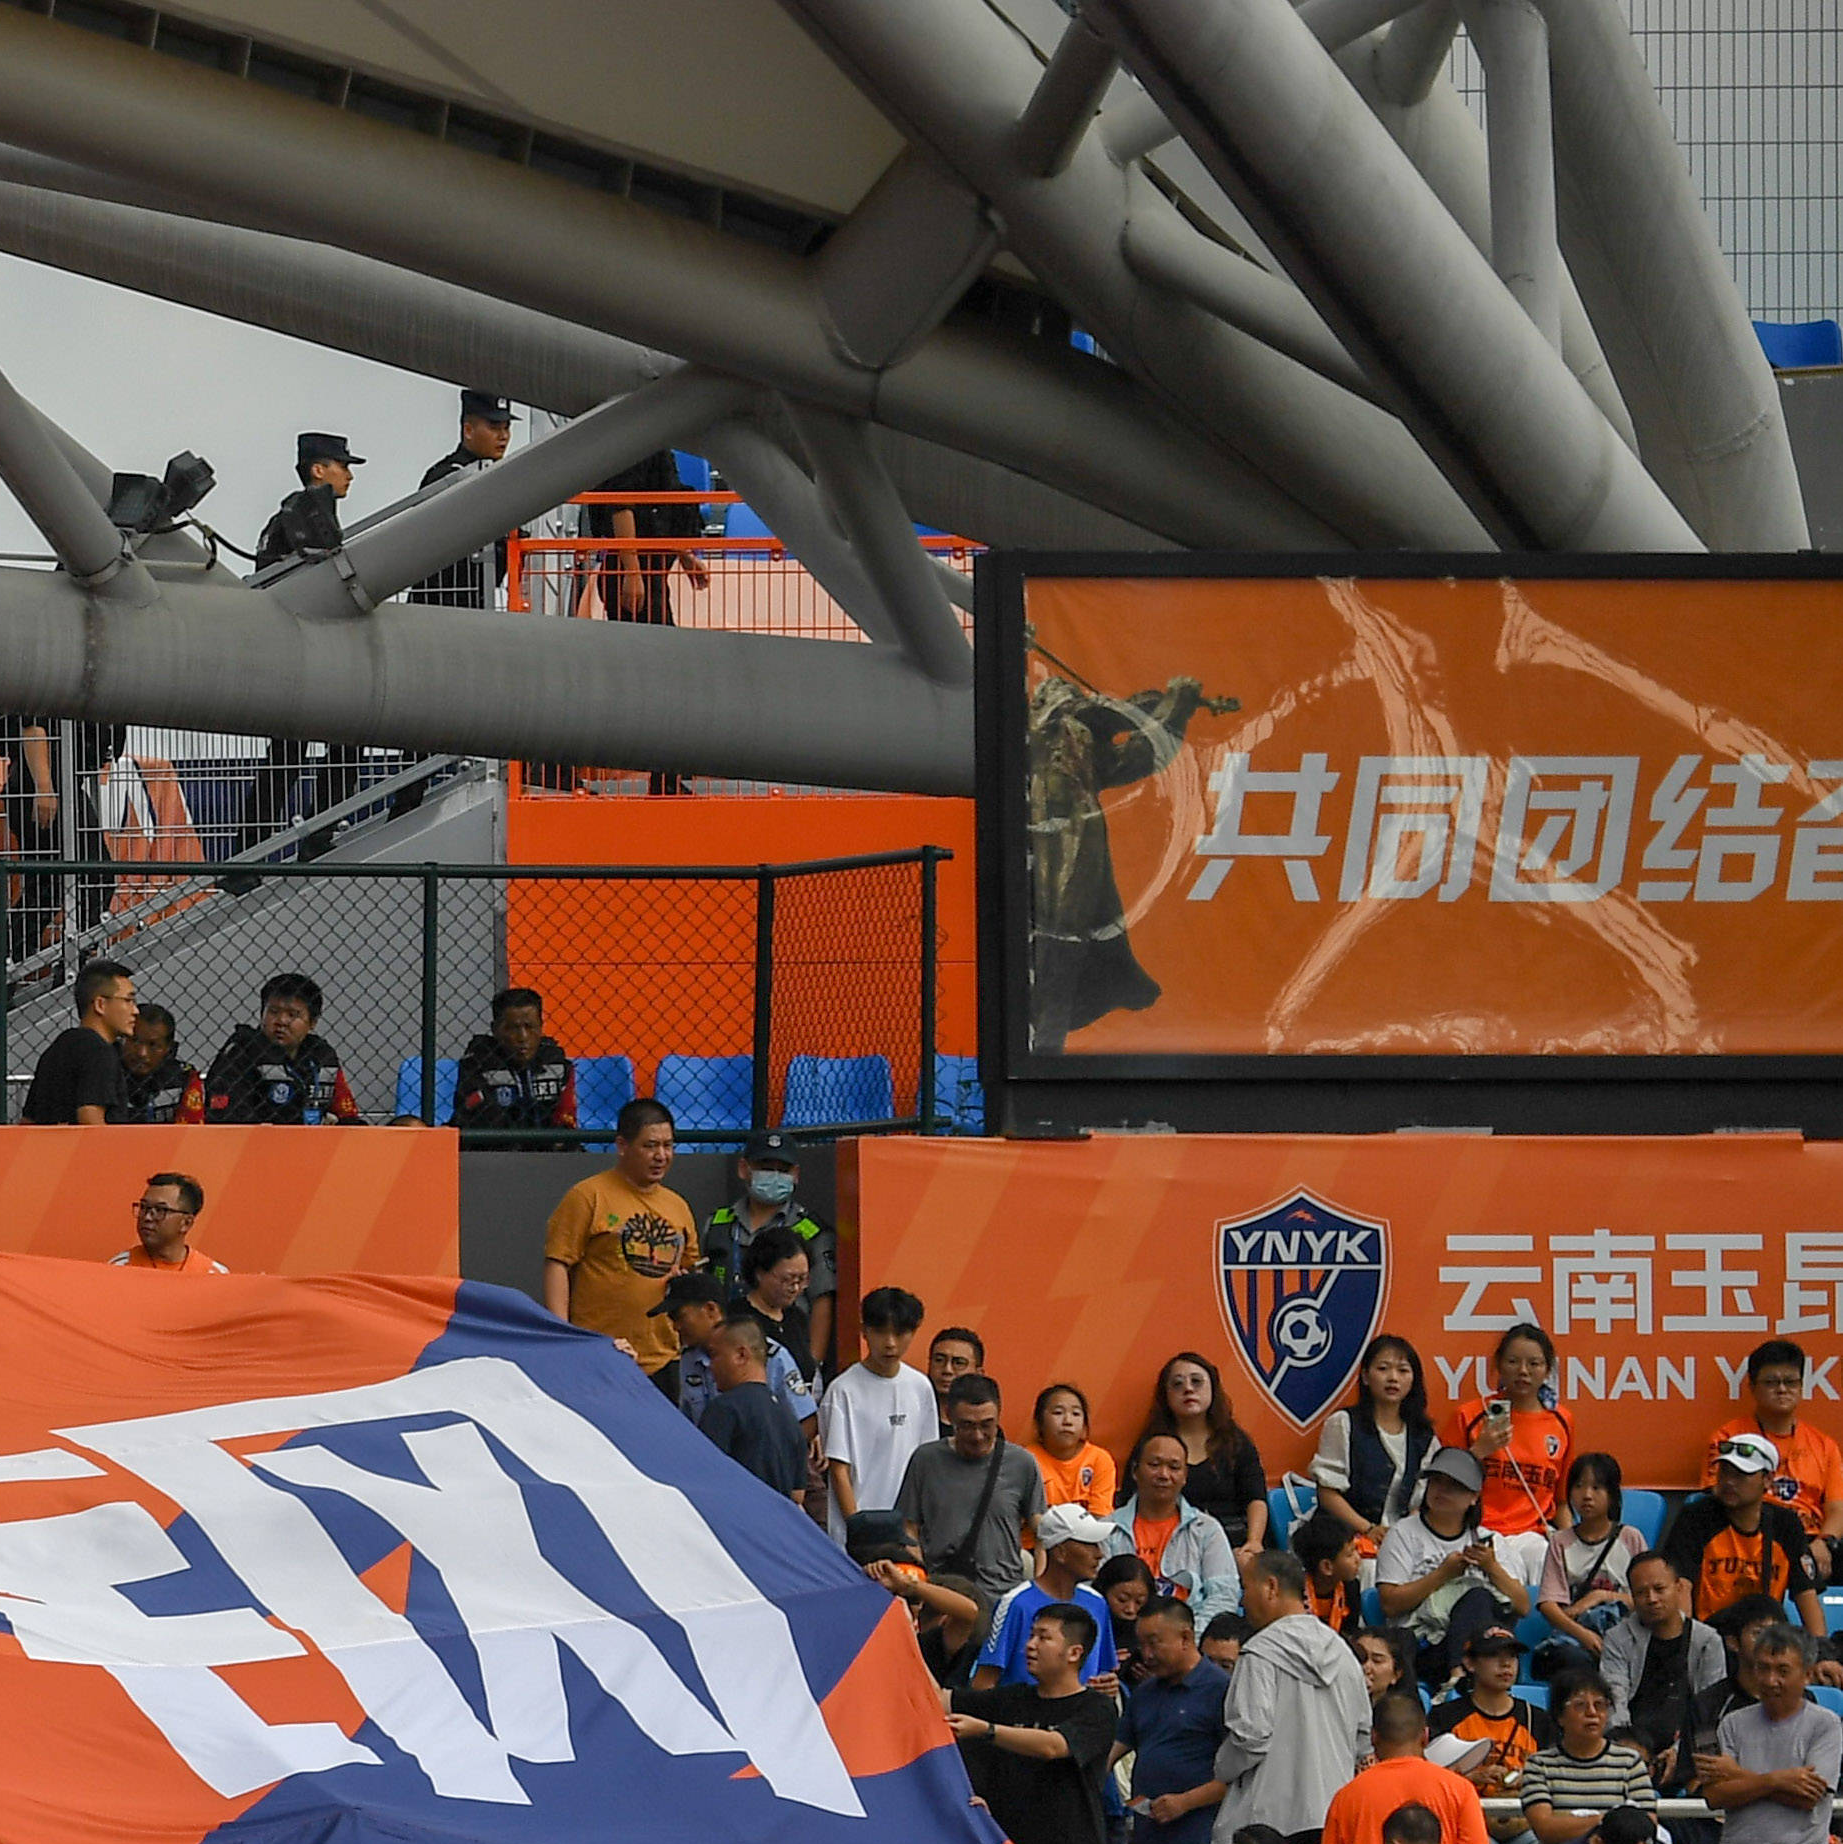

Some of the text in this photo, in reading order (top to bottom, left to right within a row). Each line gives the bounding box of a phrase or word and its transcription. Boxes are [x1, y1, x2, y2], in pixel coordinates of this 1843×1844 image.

[1230, 1228, 1372, 1265] YNYK
[1433, 1355, 1841, 1400] YUNAN YK
